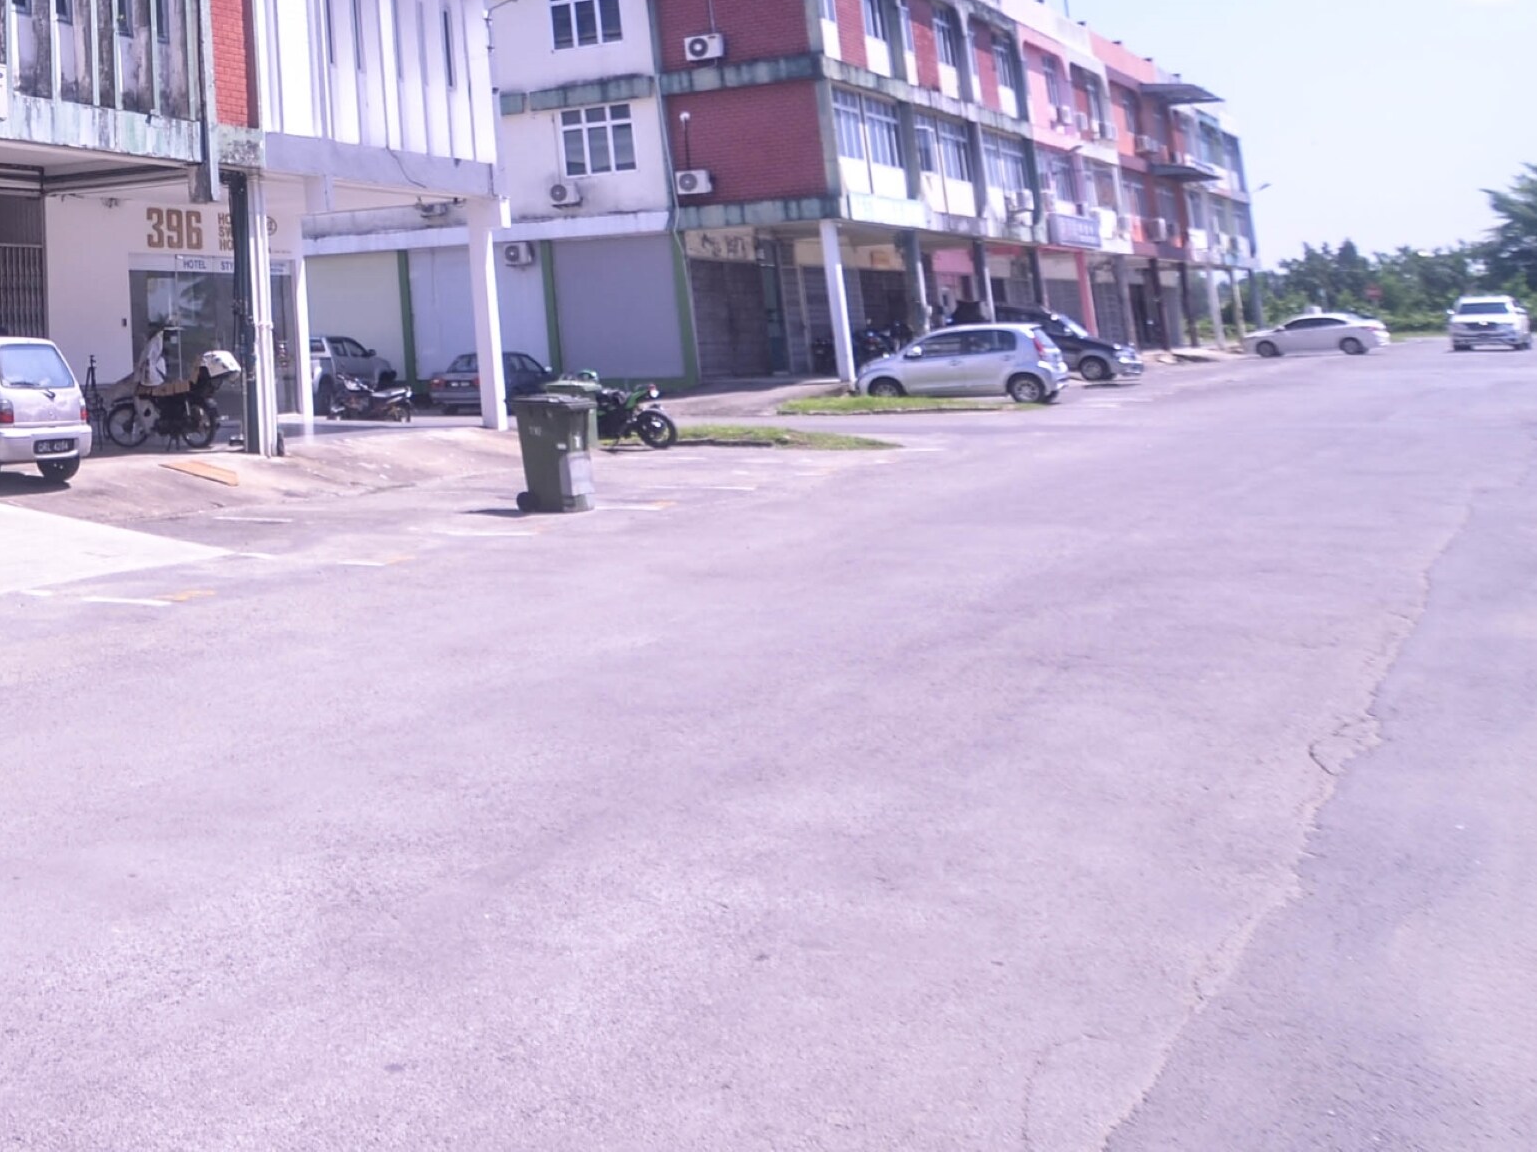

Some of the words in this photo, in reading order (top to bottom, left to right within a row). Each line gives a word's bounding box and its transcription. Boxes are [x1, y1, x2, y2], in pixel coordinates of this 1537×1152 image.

[218, 212, 232, 225] HO
[146, 207, 204, 250] 396
[219, 238, 235, 251] HO
[183, 259, 207, 270] HOTEL
